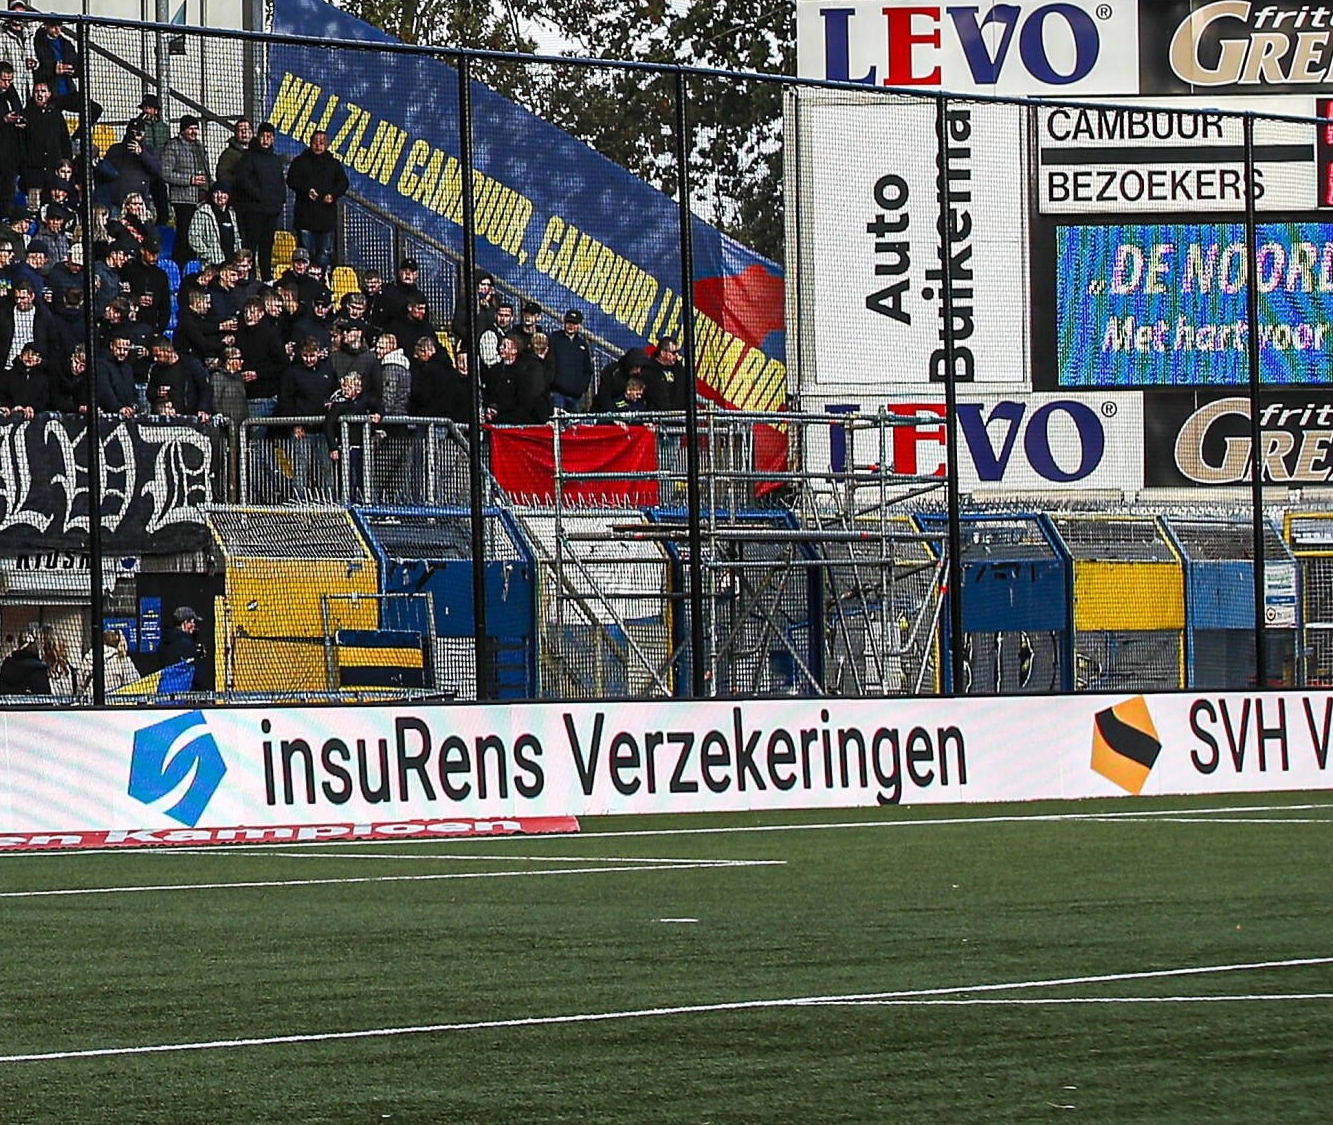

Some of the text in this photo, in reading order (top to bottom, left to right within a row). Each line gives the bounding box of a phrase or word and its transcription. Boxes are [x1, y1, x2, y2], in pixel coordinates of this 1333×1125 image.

[1169, 0, 1333, 87] GRE
[1253, 5, 1333, 29] frit
[1046, 109, 1225, 142] CAMBUUR
[269, 71, 338, 148] WIJ
[328, 101, 408, 186] ZIJN
[535, 215, 659, 337] CAMBUUR
[1047, 167, 1265, 203] BEZOEKERS
[866, 173, 911, 326] Auto
[922, 108, 975, 383] Buikema
[1102, 315, 1170, 353] Met
[1174, 313, 1250, 353] hart
[262, 707, 967, 806] insuRens Verzekeringen
[1189, 697, 1290, 775] SVH
[104, 819, 523, 844] Kampioen
